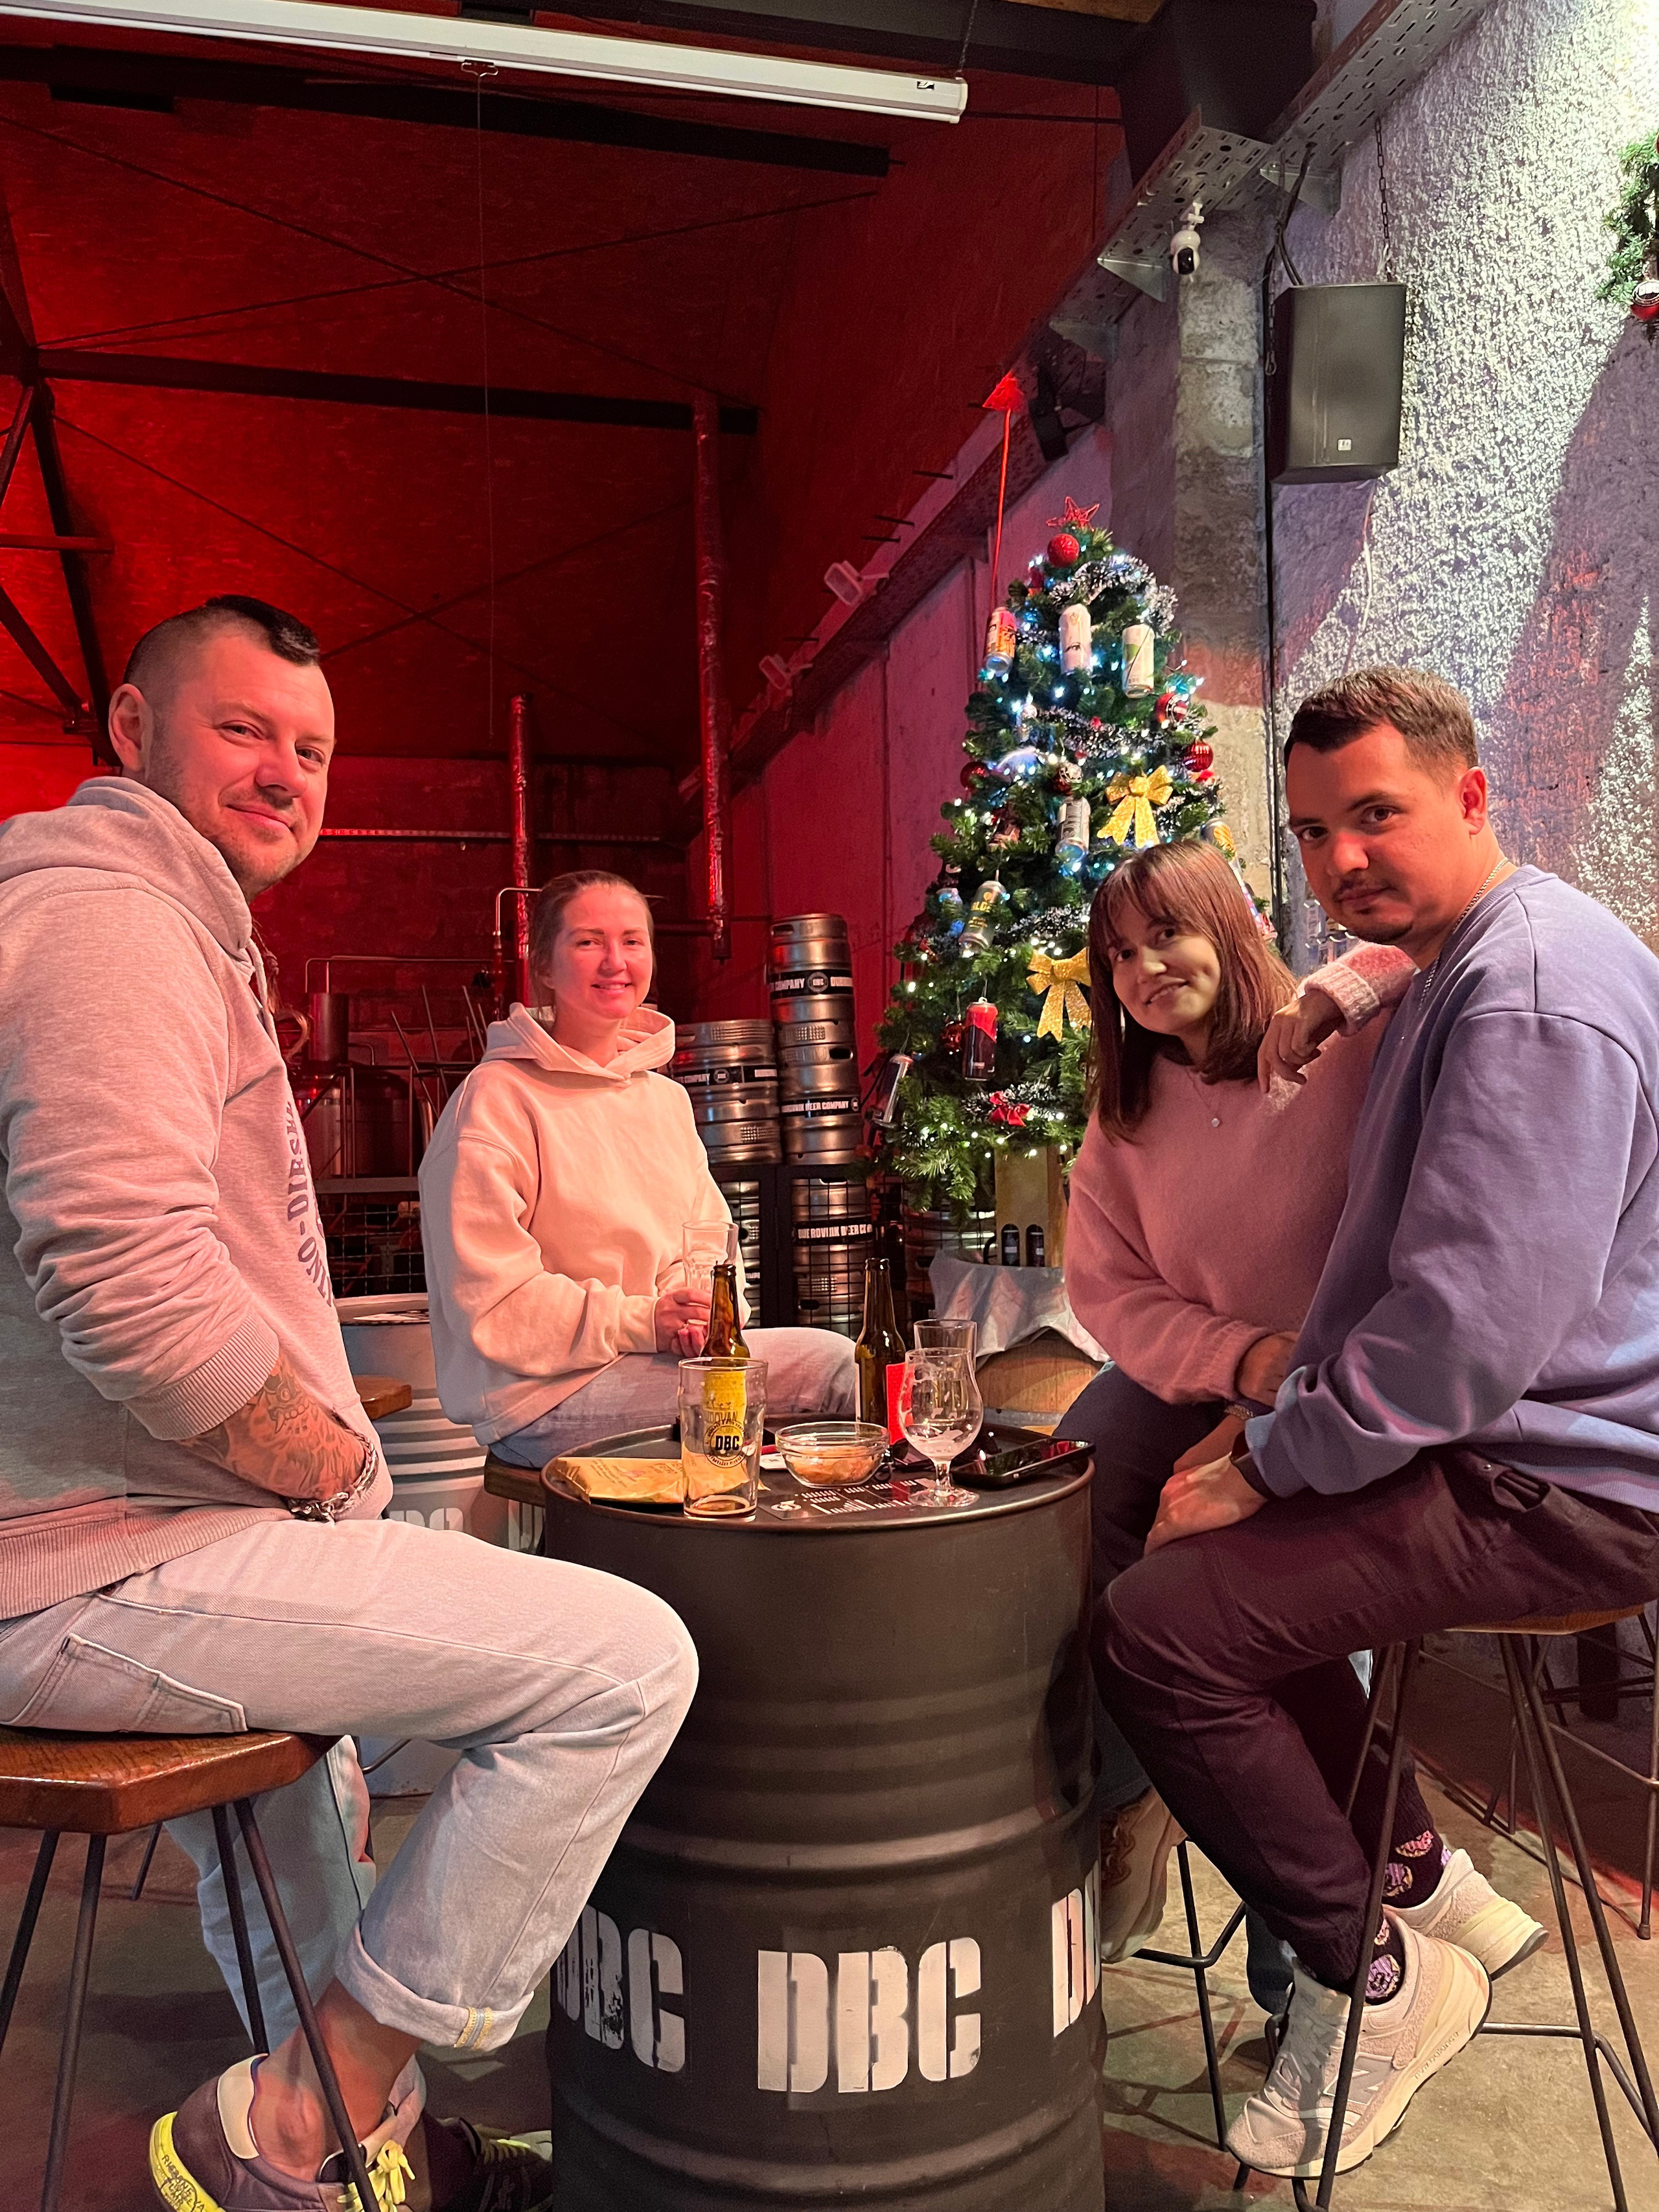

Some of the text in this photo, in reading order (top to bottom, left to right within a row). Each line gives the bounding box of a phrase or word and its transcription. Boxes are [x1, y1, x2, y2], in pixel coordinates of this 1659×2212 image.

[822, 1100, 849, 1110] COMPANY
[715, 1435, 739, 1450] DBC
[758, 1937, 981, 2093] DBC
